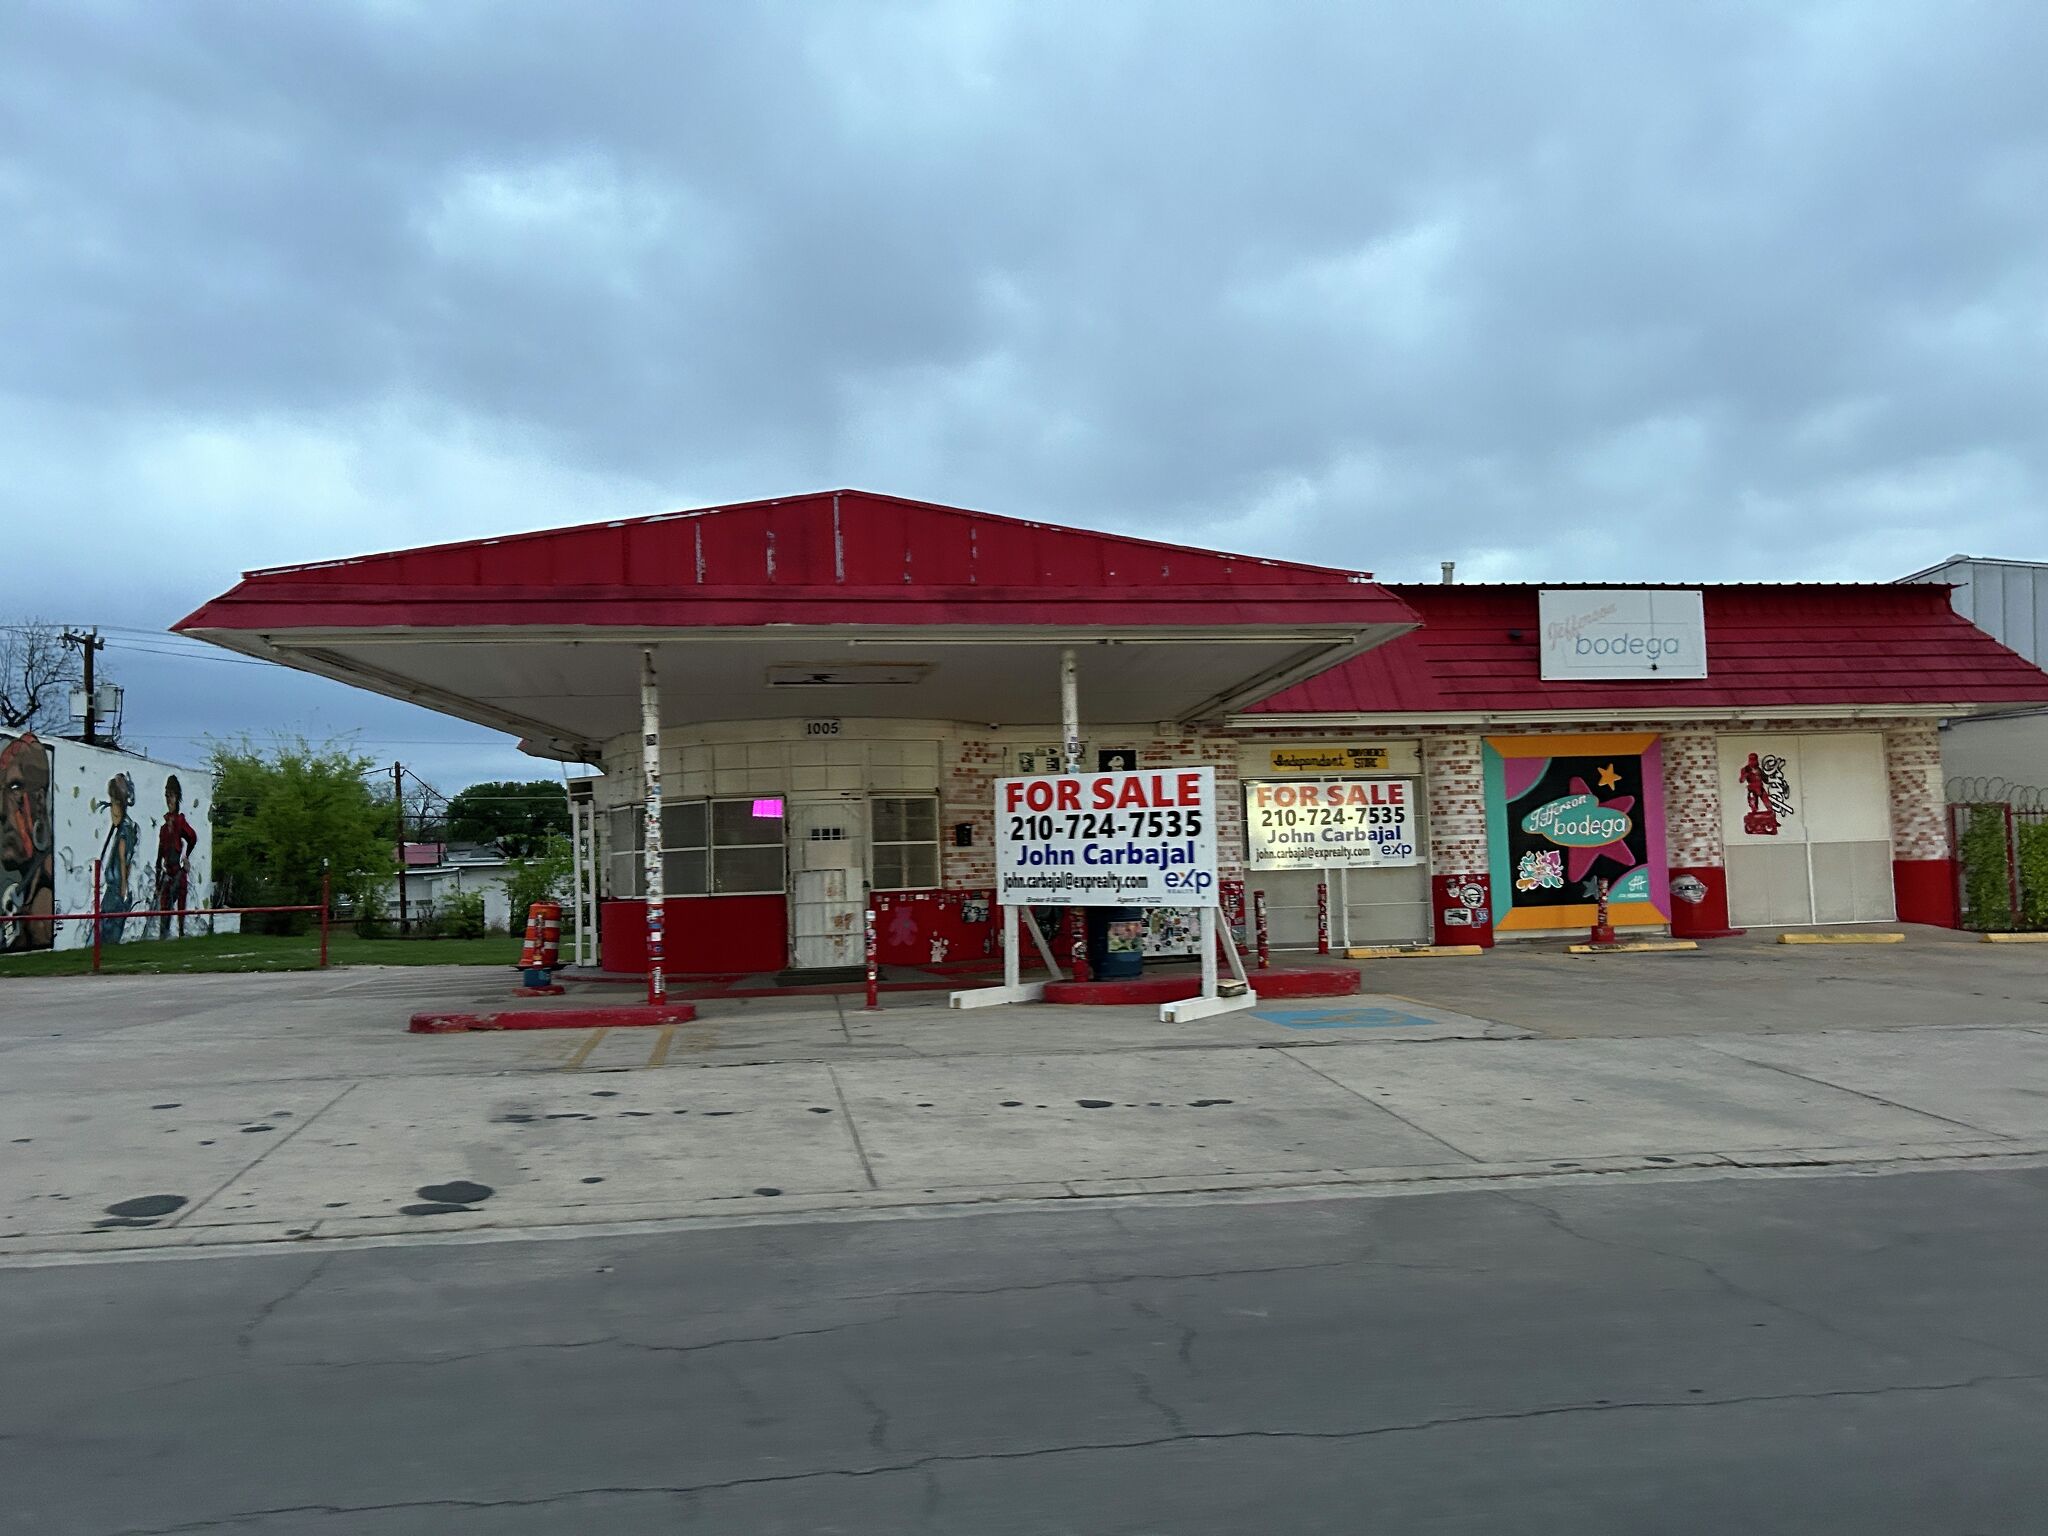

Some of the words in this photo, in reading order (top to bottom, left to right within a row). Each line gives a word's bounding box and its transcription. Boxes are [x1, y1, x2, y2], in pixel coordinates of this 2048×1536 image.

[1575, 633, 1680, 660] bodega
[807, 722, 838, 735] 1005
[1006, 780, 1082, 812] FOR
[1092, 773, 1201, 810] SALE
[1256, 786, 1320, 808] FOR
[1326, 784, 1405, 806] SALE
[1010, 810, 1202, 841] 210-724-7535
[1261, 806, 1405, 827] 210-724-7535
[1553, 814, 1626, 838] bodega
[1267, 828, 1315, 844] John
[1321, 825, 1402, 844] Carbajal
[1016, 843, 1075, 866] John
[1083, 840, 1195, 871] Carbajal
[1255, 846, 1371, 863] john.carbajal@exprealty.com
[1003, 871, 1148, 893] john.carbajal@exprealty.com
